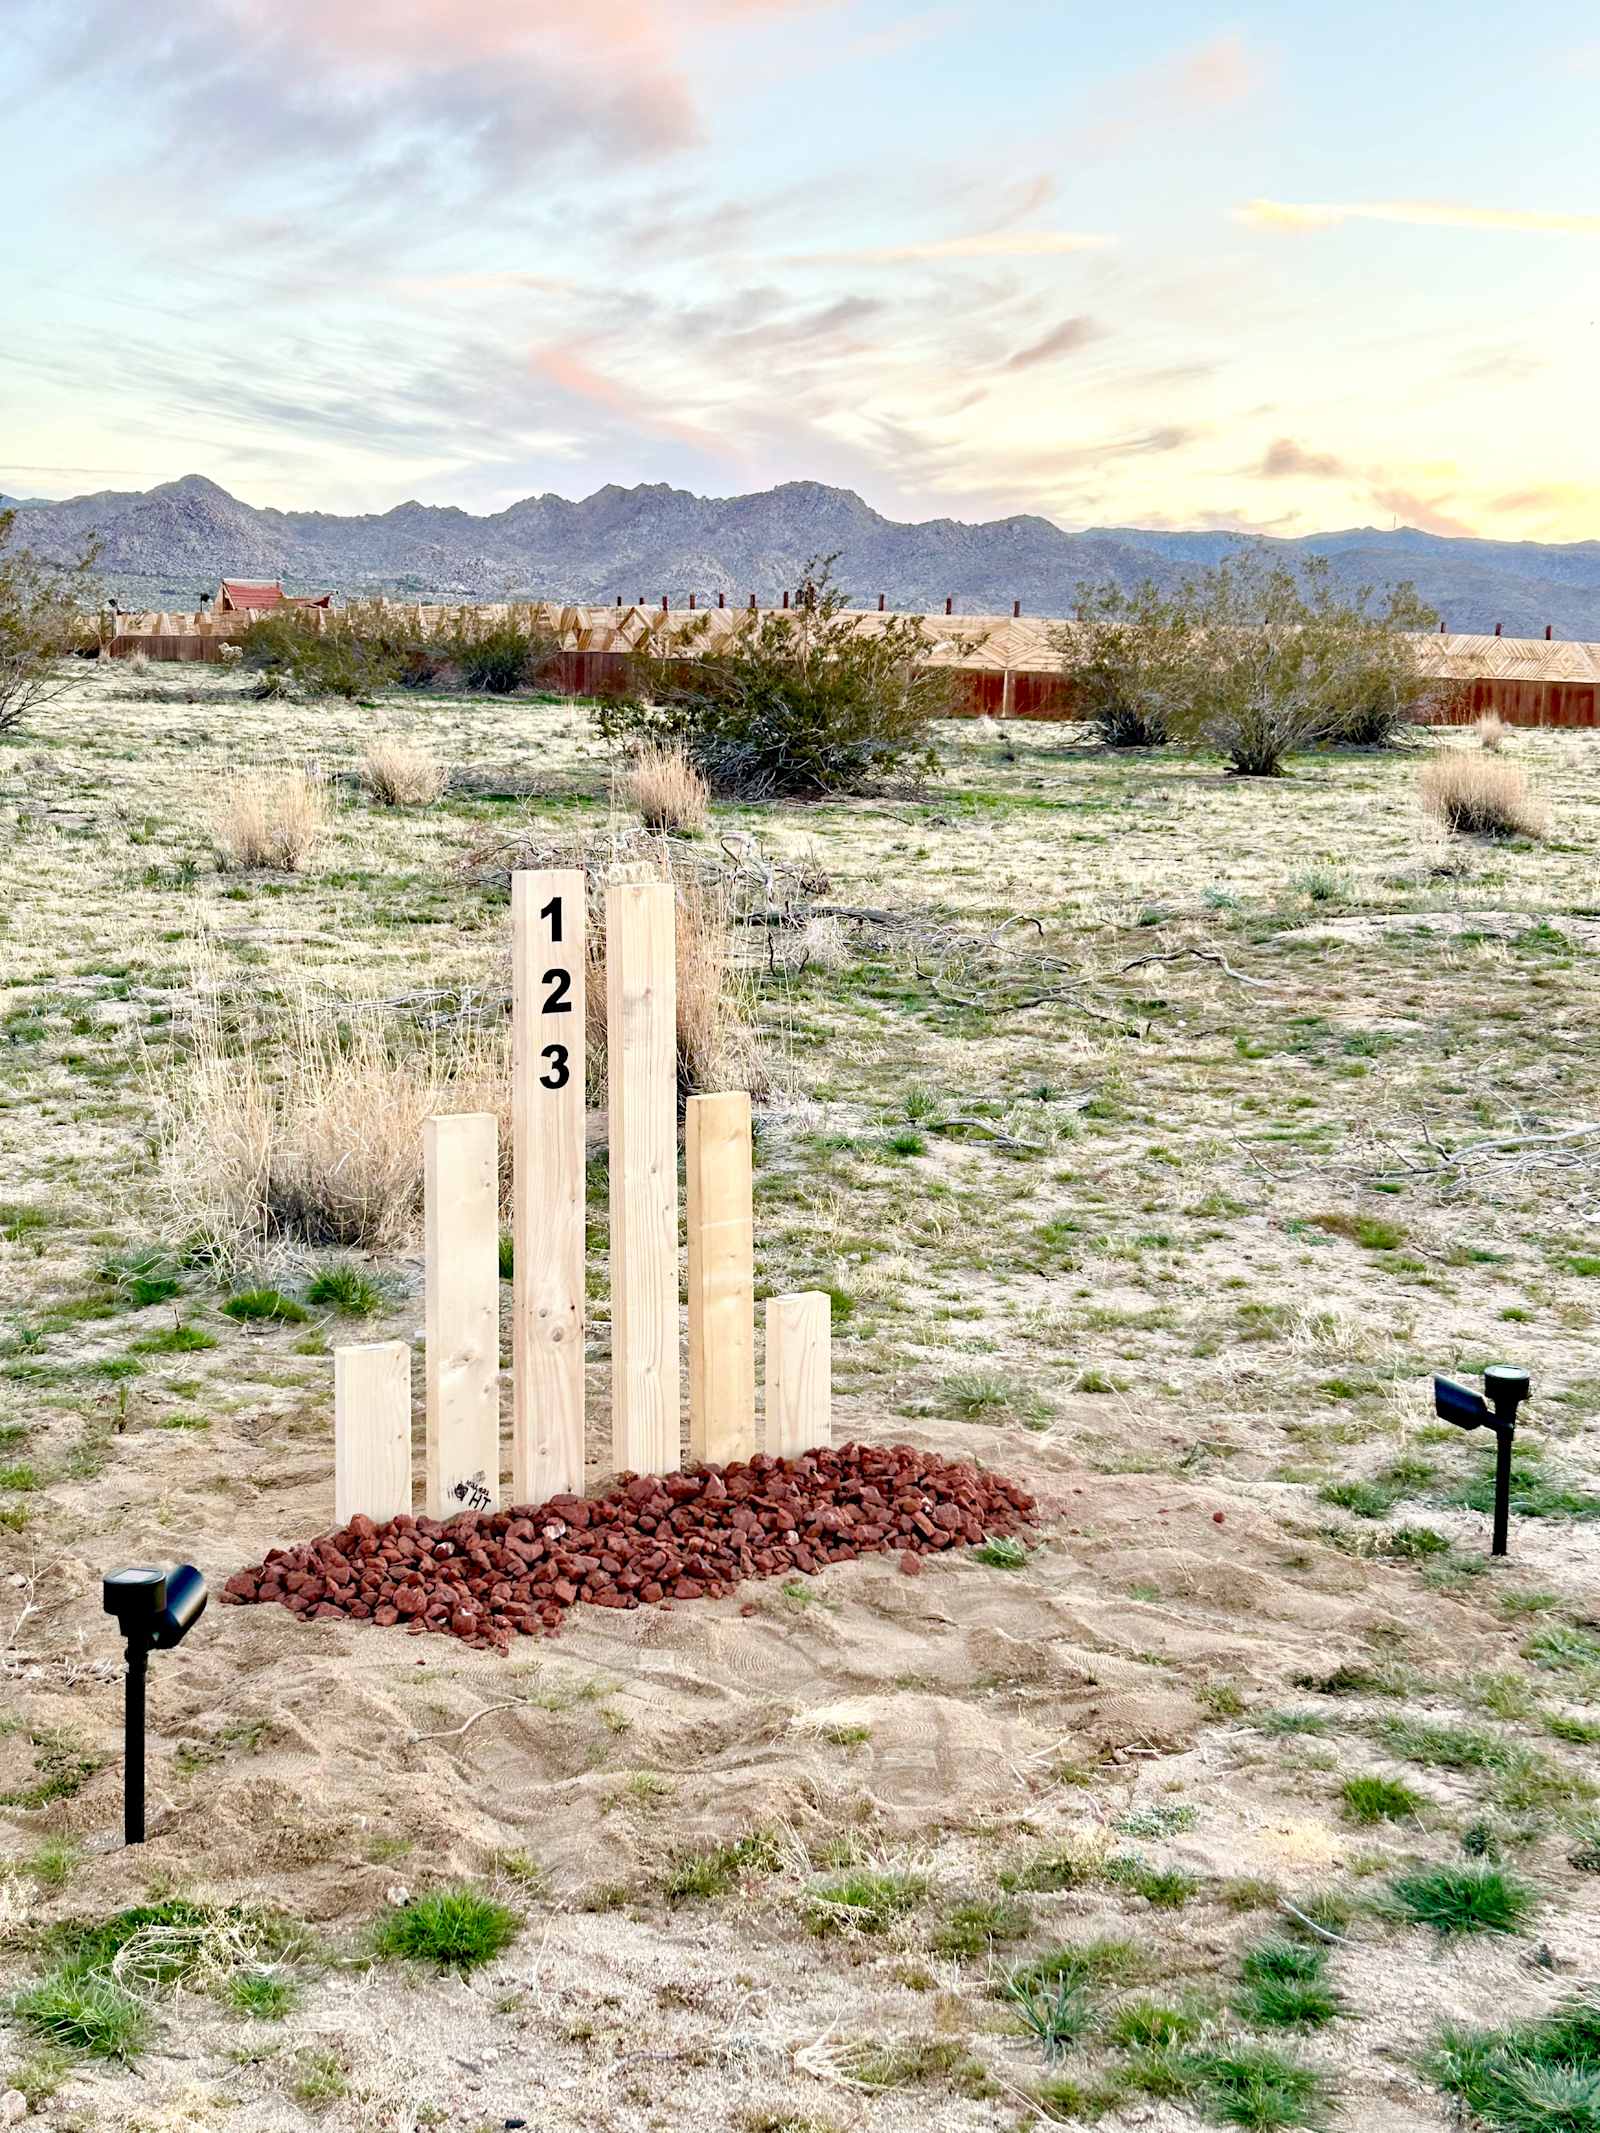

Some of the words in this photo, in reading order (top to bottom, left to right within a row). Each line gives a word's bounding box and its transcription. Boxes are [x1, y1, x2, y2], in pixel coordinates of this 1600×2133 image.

[541, 897, 562, 942] 1
[542, 968, 572, 1014] 2
[540, 1044, 570, 1089] 3
[468, 1489, 491, 1511] HT
